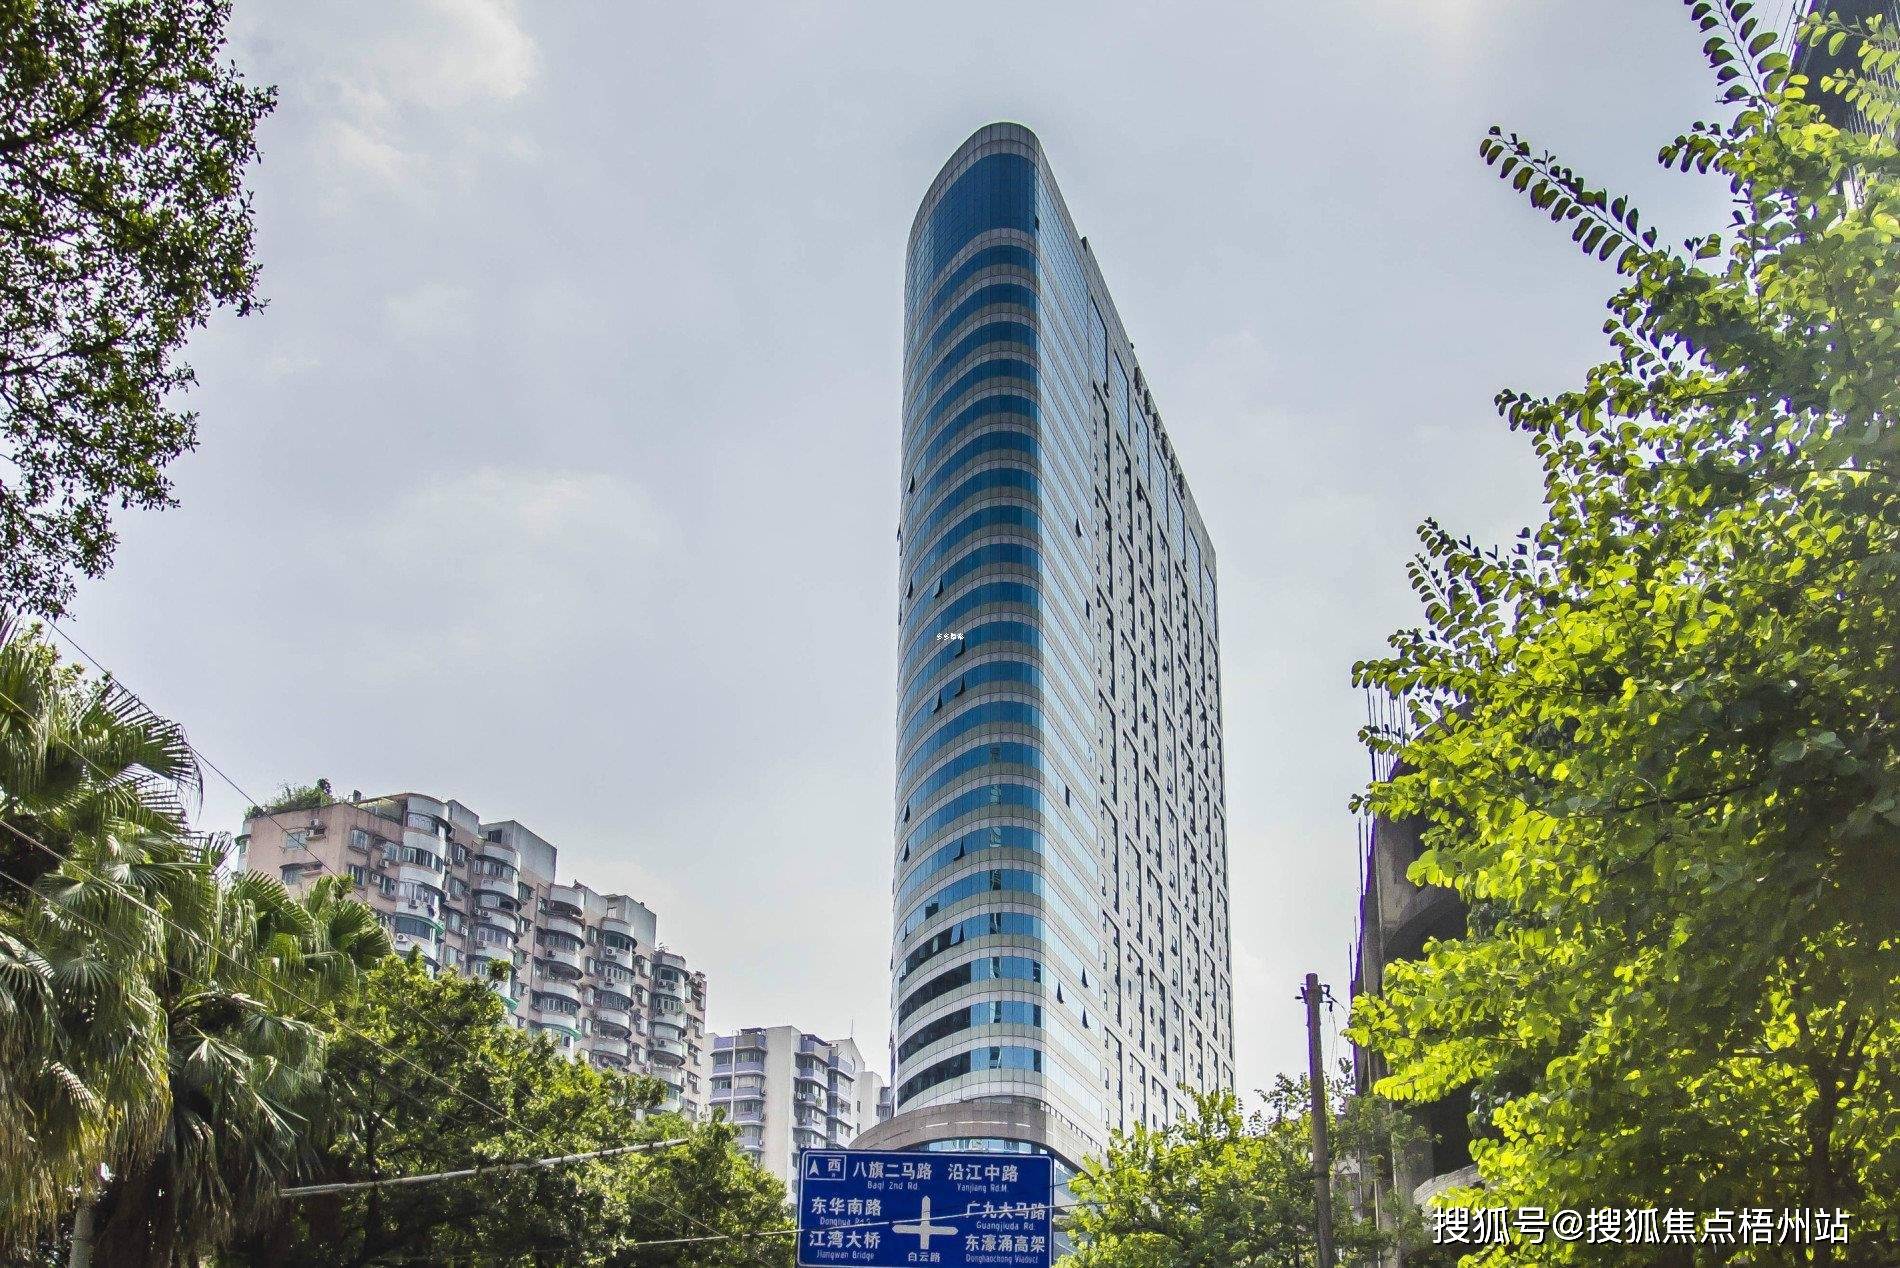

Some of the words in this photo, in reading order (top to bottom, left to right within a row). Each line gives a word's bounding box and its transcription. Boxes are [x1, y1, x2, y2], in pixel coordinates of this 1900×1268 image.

[827, 1158, 842, 1172] 西
[852, 1161, 932, 1180] 八旗二马路
[948, 1163, 1019, 1182] 沿江中路
[888, 1181, 903, 1190] 2nd
[957, 1183, 987, 1194] Yanjiang
[811, 1197, 882, 1216] 东华南路
[965, 1200, 1046, 1220] 广九大马路
[809, 1230, 881, 1249] 江湾大桥
[965, 1234, 1046, 1253] 东濠涌高架
[816, 1250, 849, 1260] Jiangwan
[852, 1250, 875, 1261] Bridge
[907, 1252, 941, 1263] 白云路
